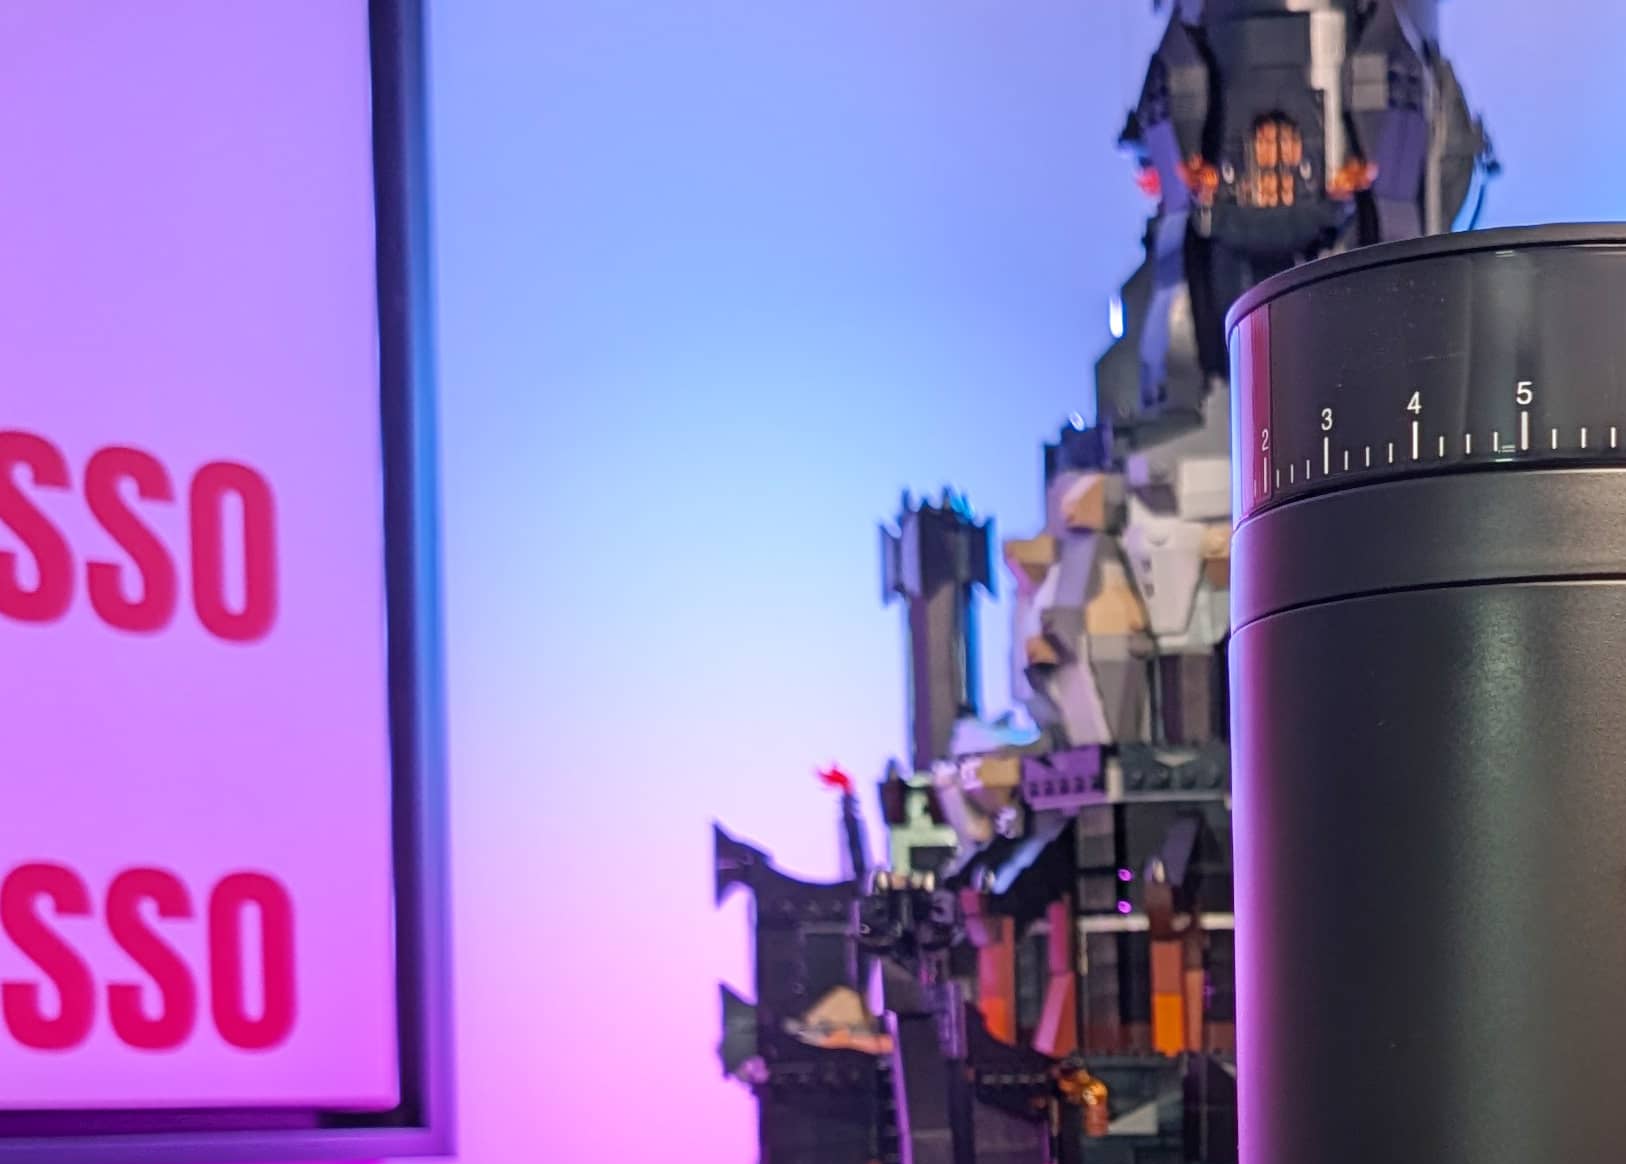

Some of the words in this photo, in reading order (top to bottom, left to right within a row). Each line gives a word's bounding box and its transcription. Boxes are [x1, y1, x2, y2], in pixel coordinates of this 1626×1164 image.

[1261, 428, 1270, 451] 2
[1321, 407, 1333, 431] 3
[1407, 391, 1422, 415] 4
[1516, 381, 1533, 406] 5
[0, 430, 279, 645] SSO
[0, 860, 298, 1053] SSO
